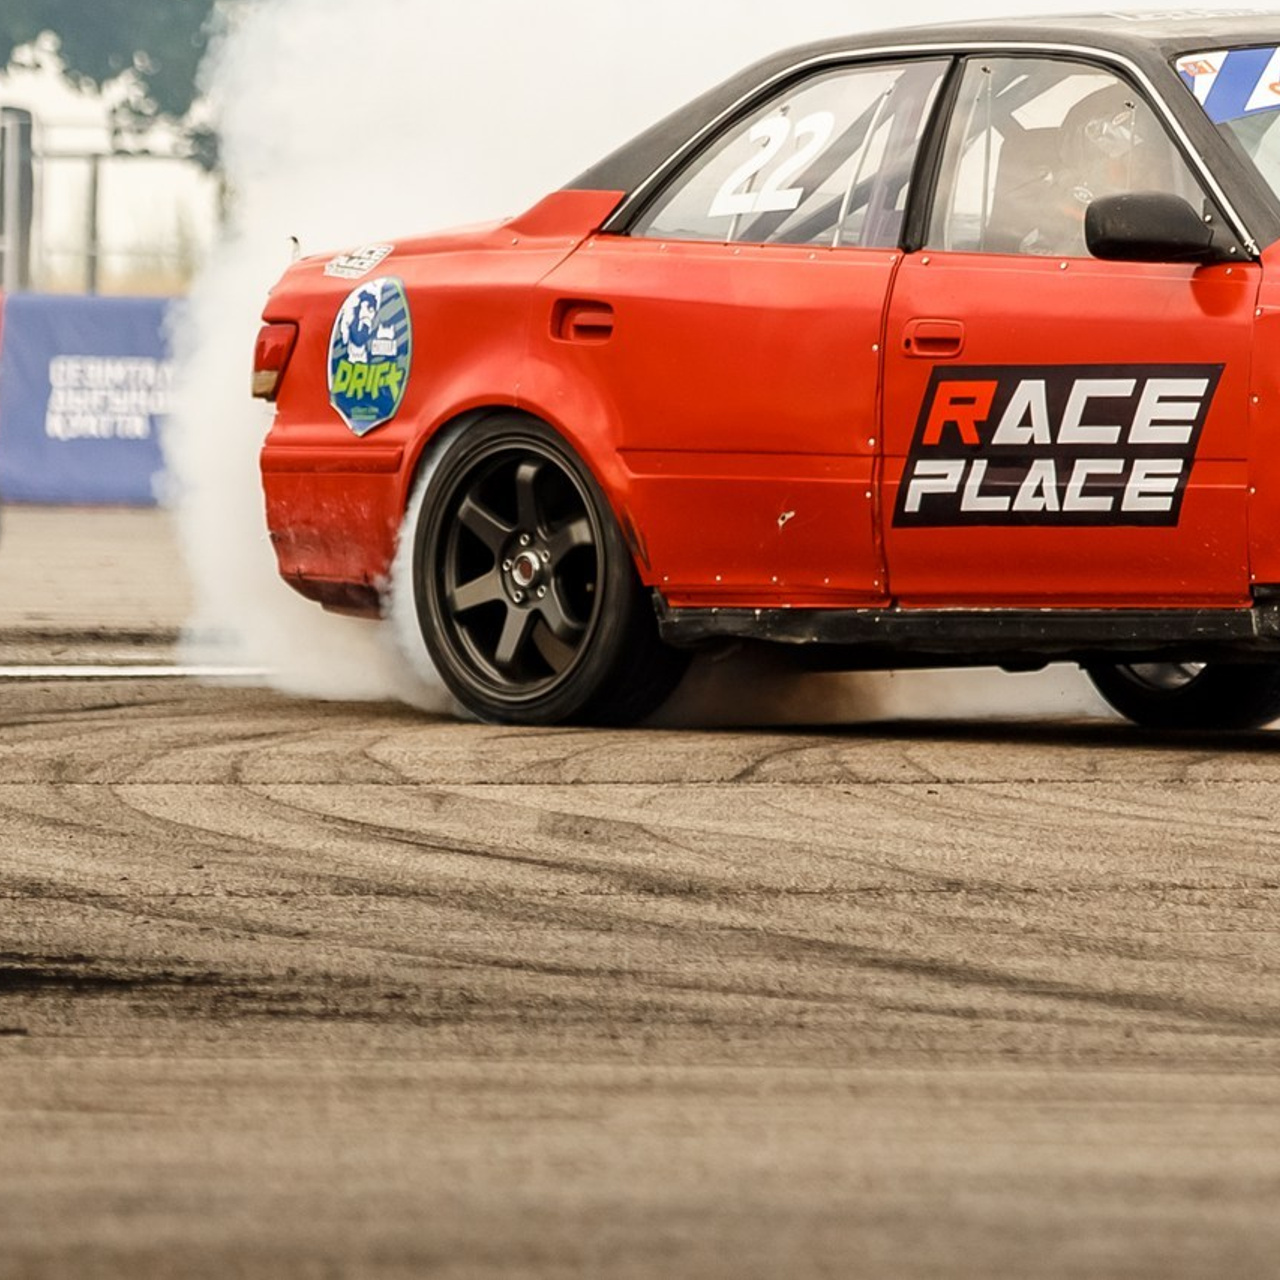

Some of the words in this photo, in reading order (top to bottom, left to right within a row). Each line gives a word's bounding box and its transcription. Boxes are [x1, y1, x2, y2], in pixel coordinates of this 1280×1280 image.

[708, 111, 835, 217] 22
[333, 360, 403, 402] DRIFT
[922, 378, 1209, 445] RACE
[904, 458, 1184, 512] PLACE
